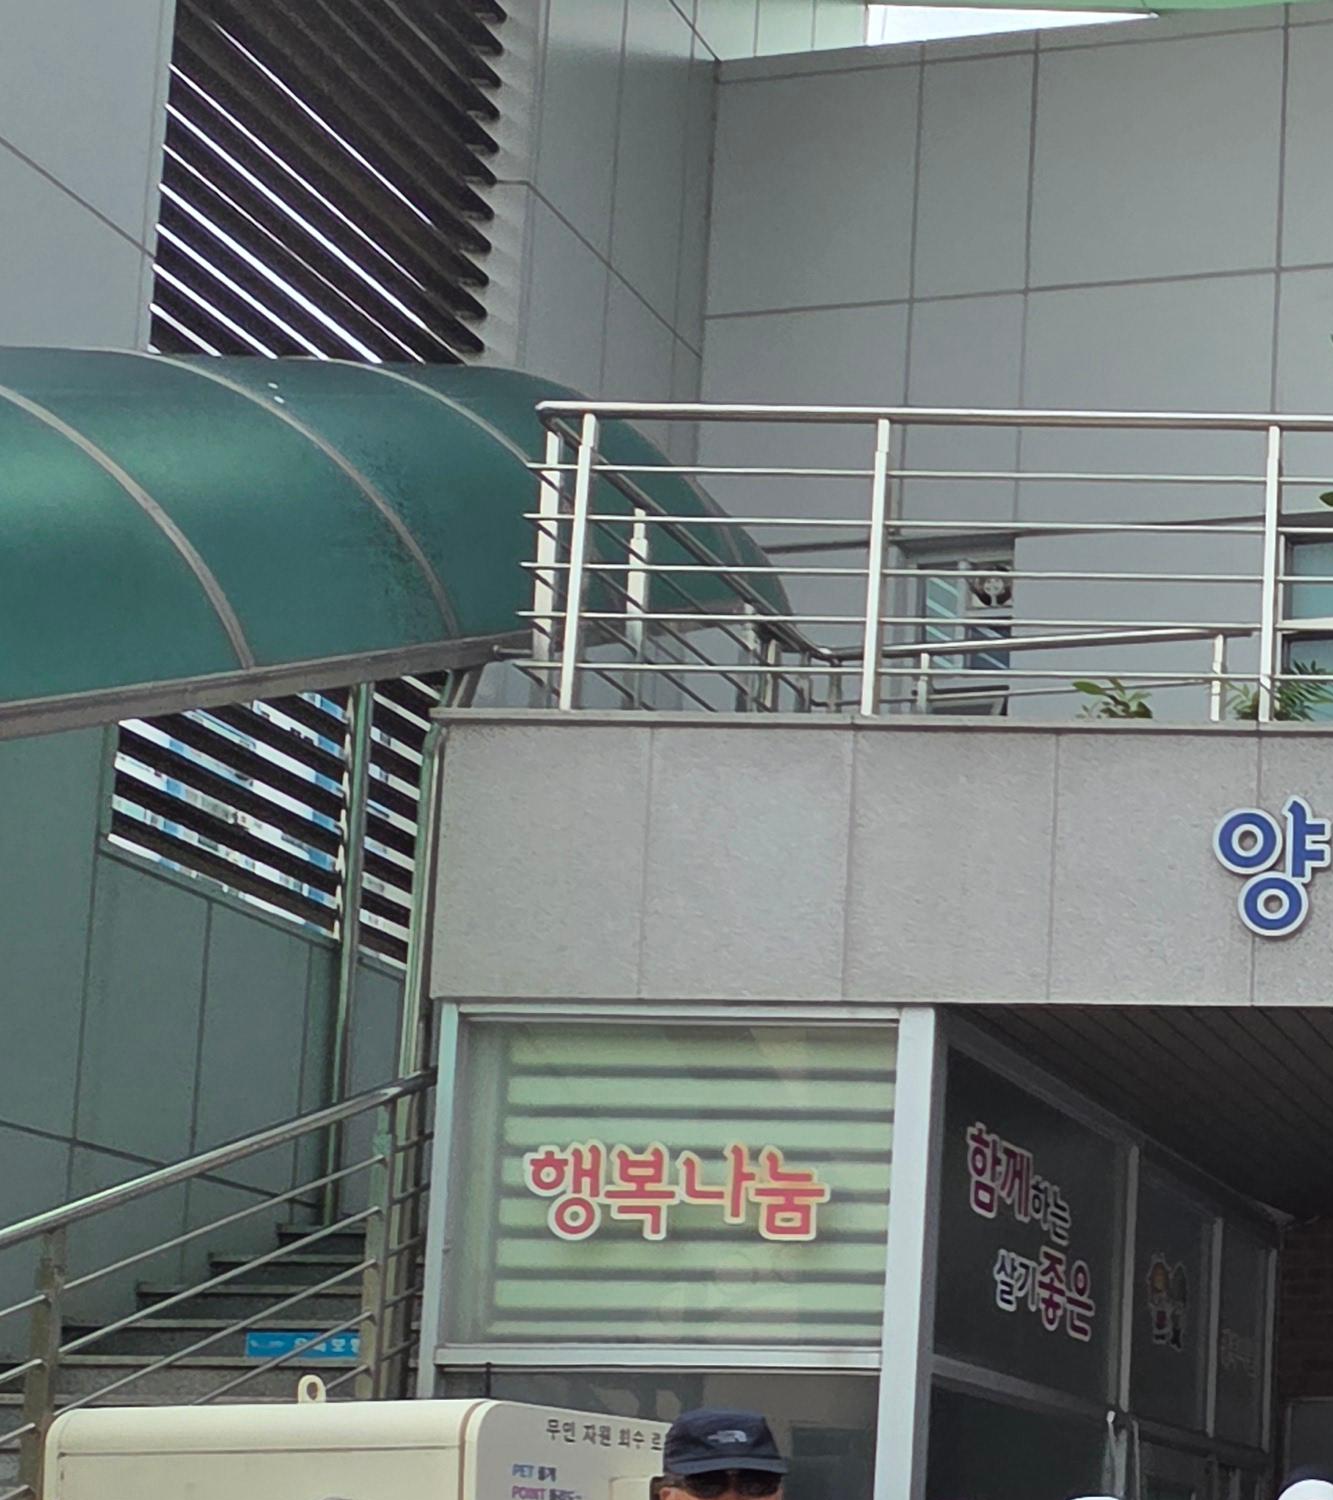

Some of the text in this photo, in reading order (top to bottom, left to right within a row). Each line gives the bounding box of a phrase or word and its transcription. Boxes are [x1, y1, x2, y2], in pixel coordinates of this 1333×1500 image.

[524, 1138, 830, 1241] 행복나눔
[967, 1122, 1071, 1246] 함께하는
[546, 1419, 576, 1443] 무인
[582, 1424, 611, 1447] 자원
[618, 1428, 645, 1449] 회수
